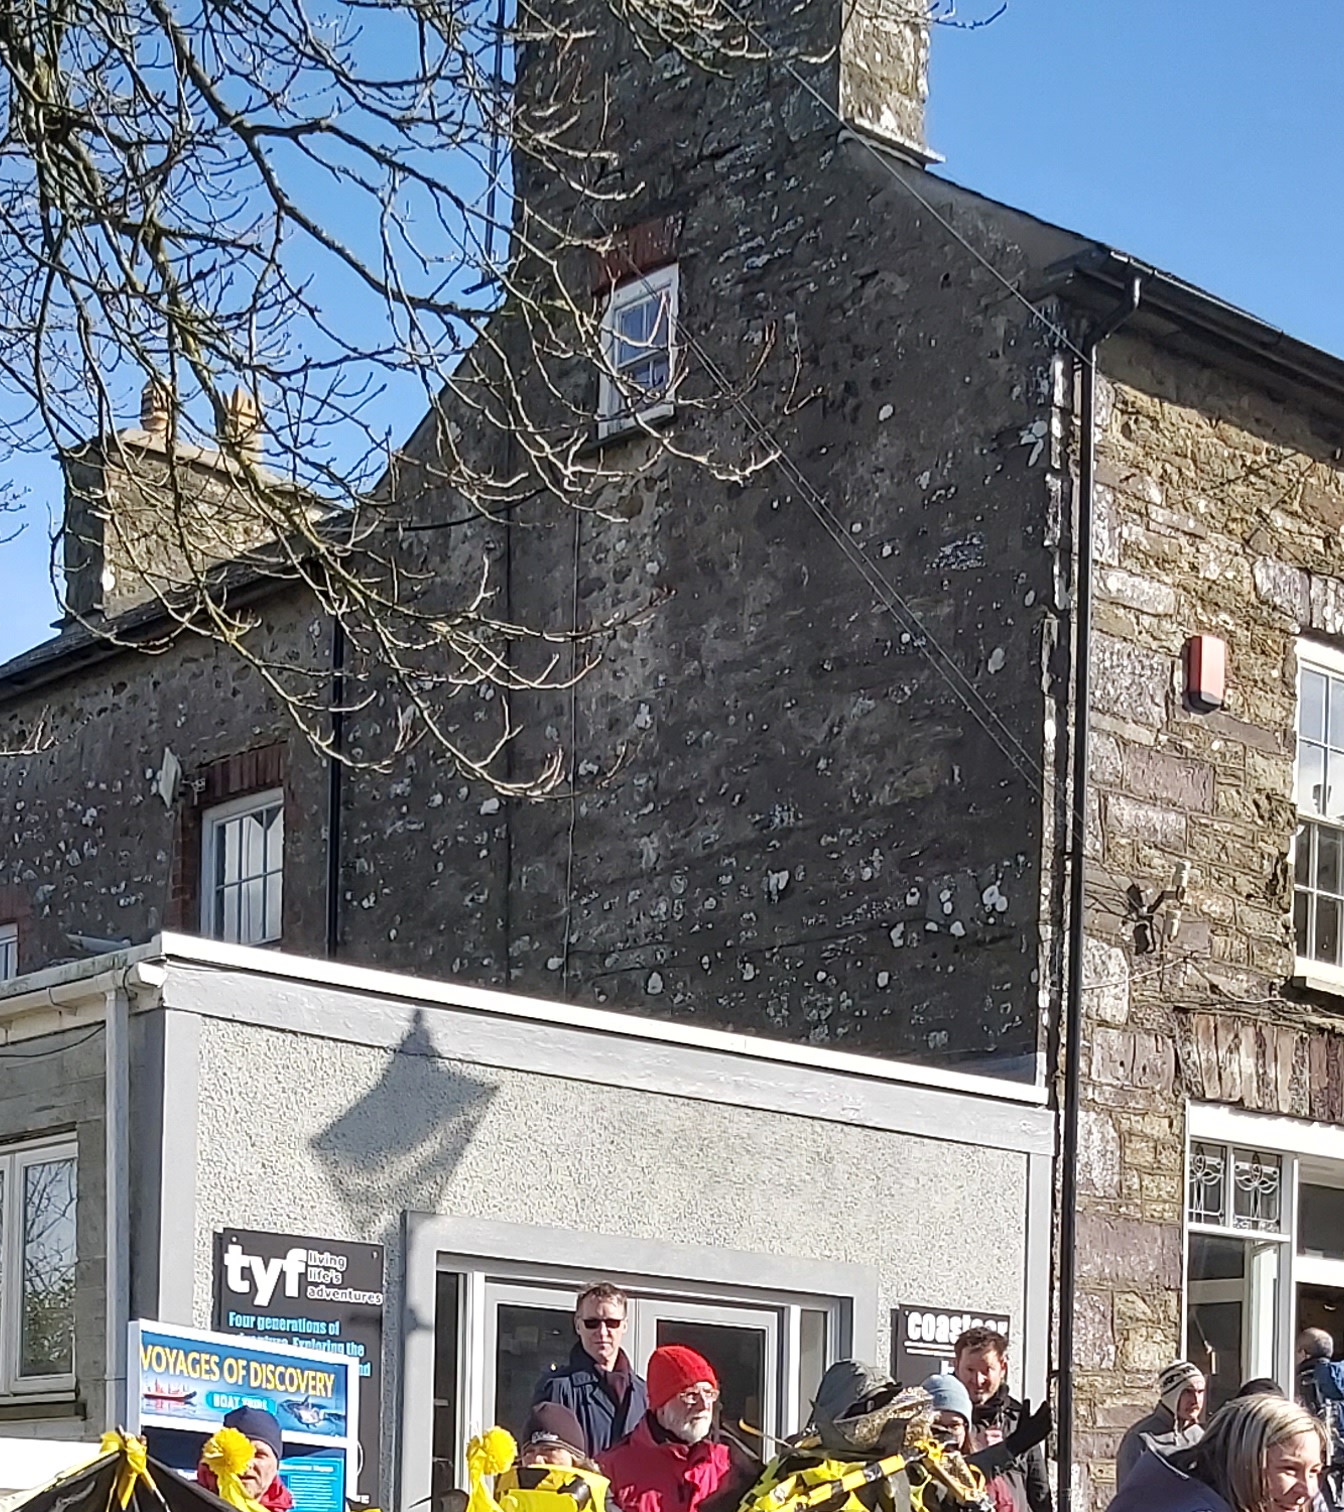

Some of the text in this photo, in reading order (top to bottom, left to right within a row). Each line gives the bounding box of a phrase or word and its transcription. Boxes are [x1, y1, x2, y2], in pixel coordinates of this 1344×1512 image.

[308, 1249, 347, 1269] living
[223, 1243, 307, 1307] tyf
[308, 1269, 342, 1285] life's
[306, 1285, 384, 1306] adventures
[228, 1311, 340, 1336] Four generations of
[346, 1341, 365, 1357] the
[140, 1343, 335, 1399] VOYAGES OF DISCOVERY
